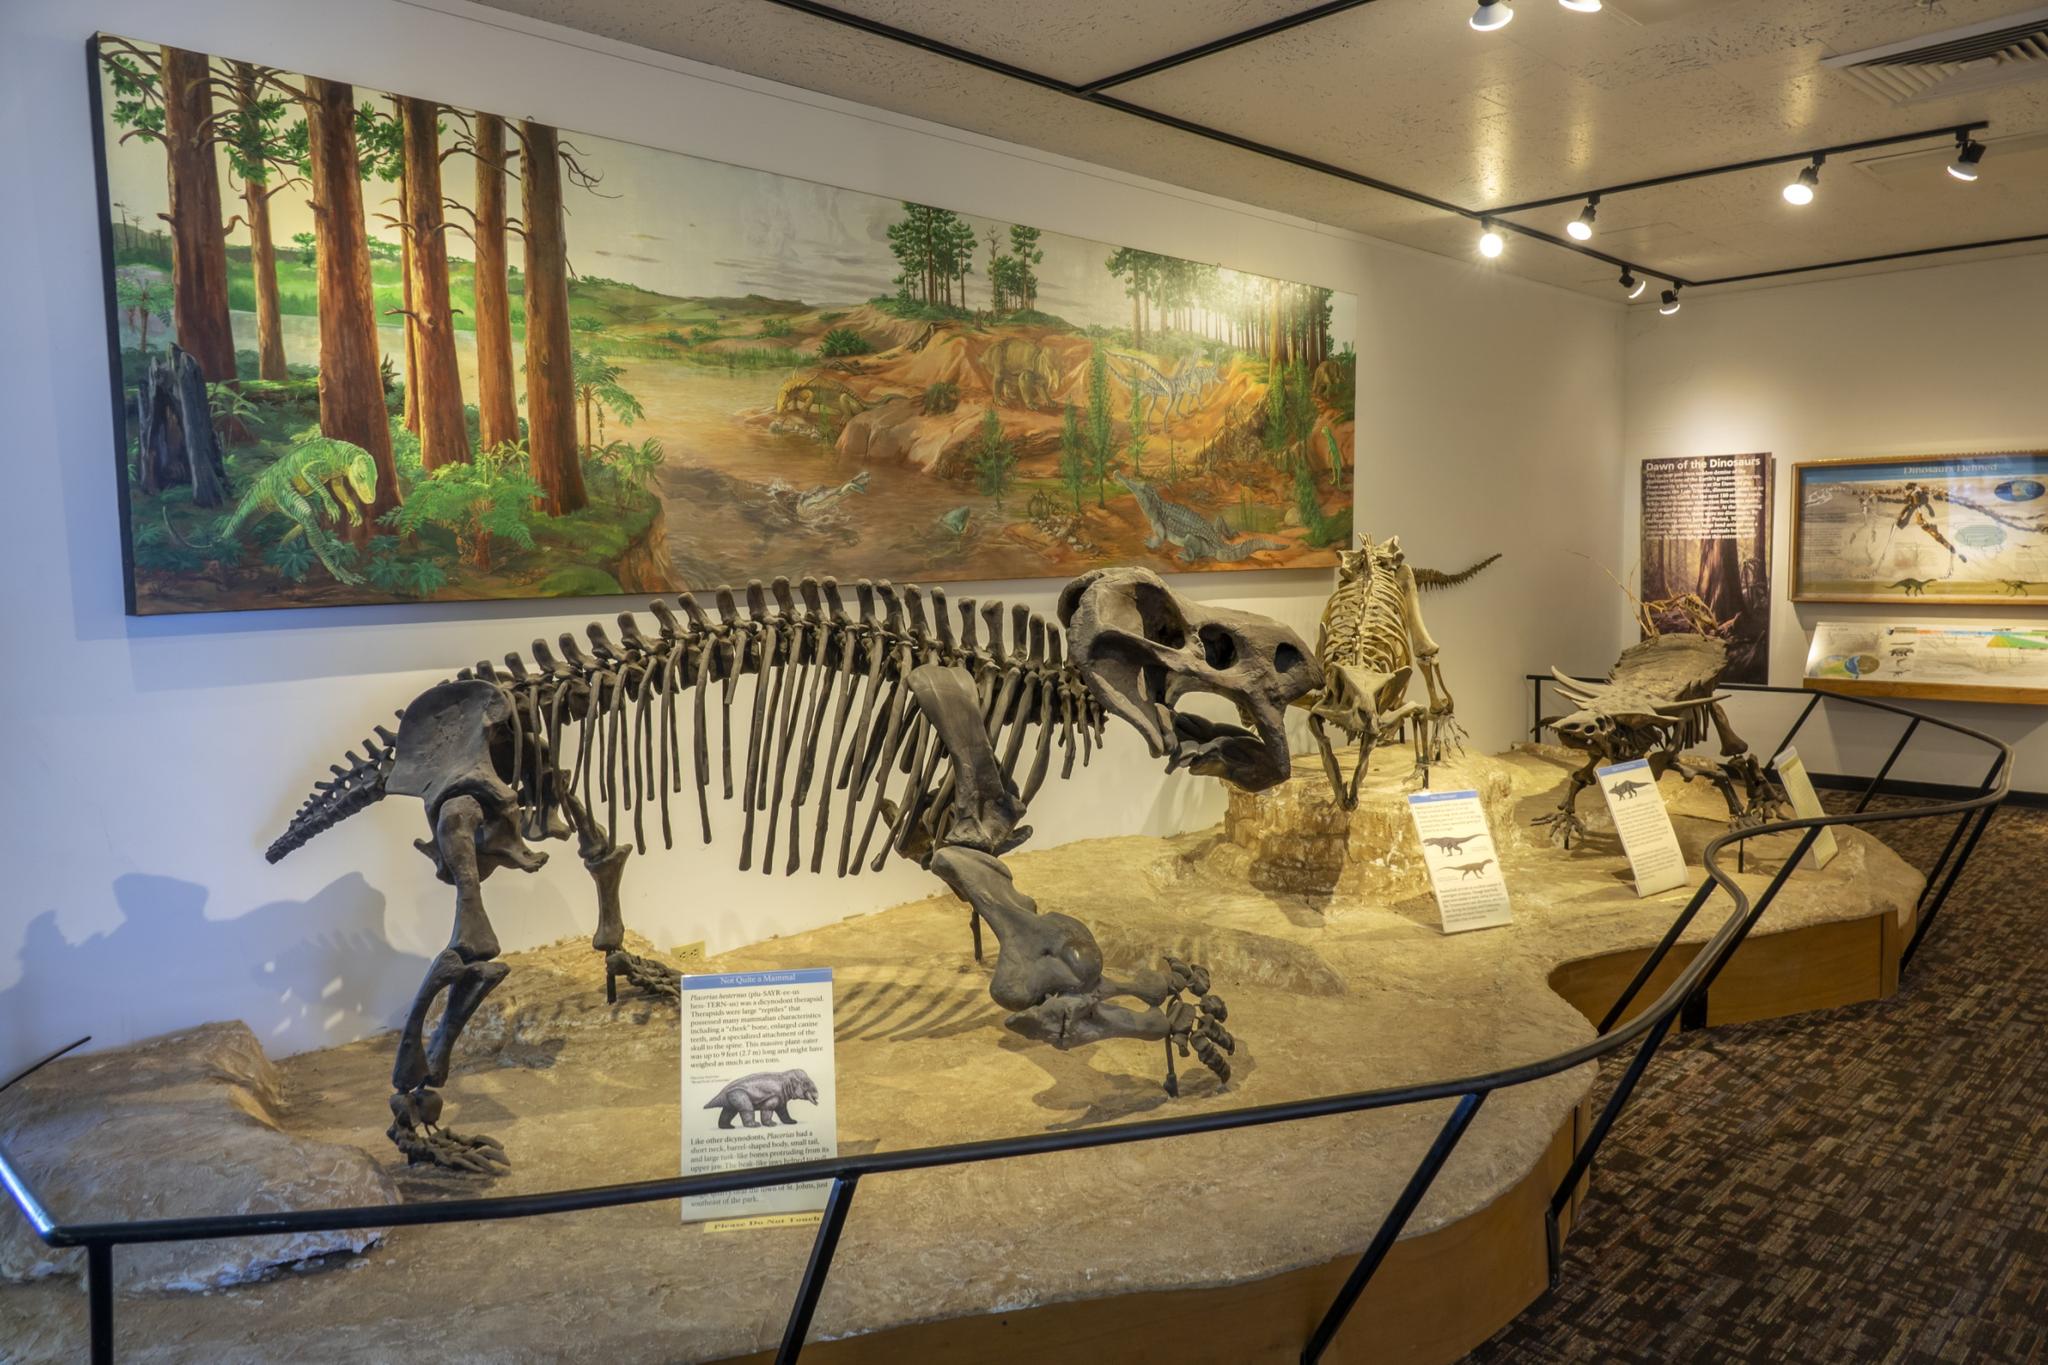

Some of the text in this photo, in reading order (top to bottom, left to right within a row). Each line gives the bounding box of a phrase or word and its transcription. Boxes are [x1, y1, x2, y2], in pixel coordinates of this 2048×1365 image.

[1646, 458, 1761, 471] Dawn of the Dinosaurs
[1903, 464, 1998, 474] Dinosaurs Defined
[720, 976, 734, 984] Not
[735, 975, 756, 985] Quite
[763, 973, 796, 982] Mammal
[714, 1221, 746, 1230] Please
[790, 1215, 821, 1223] Touch
